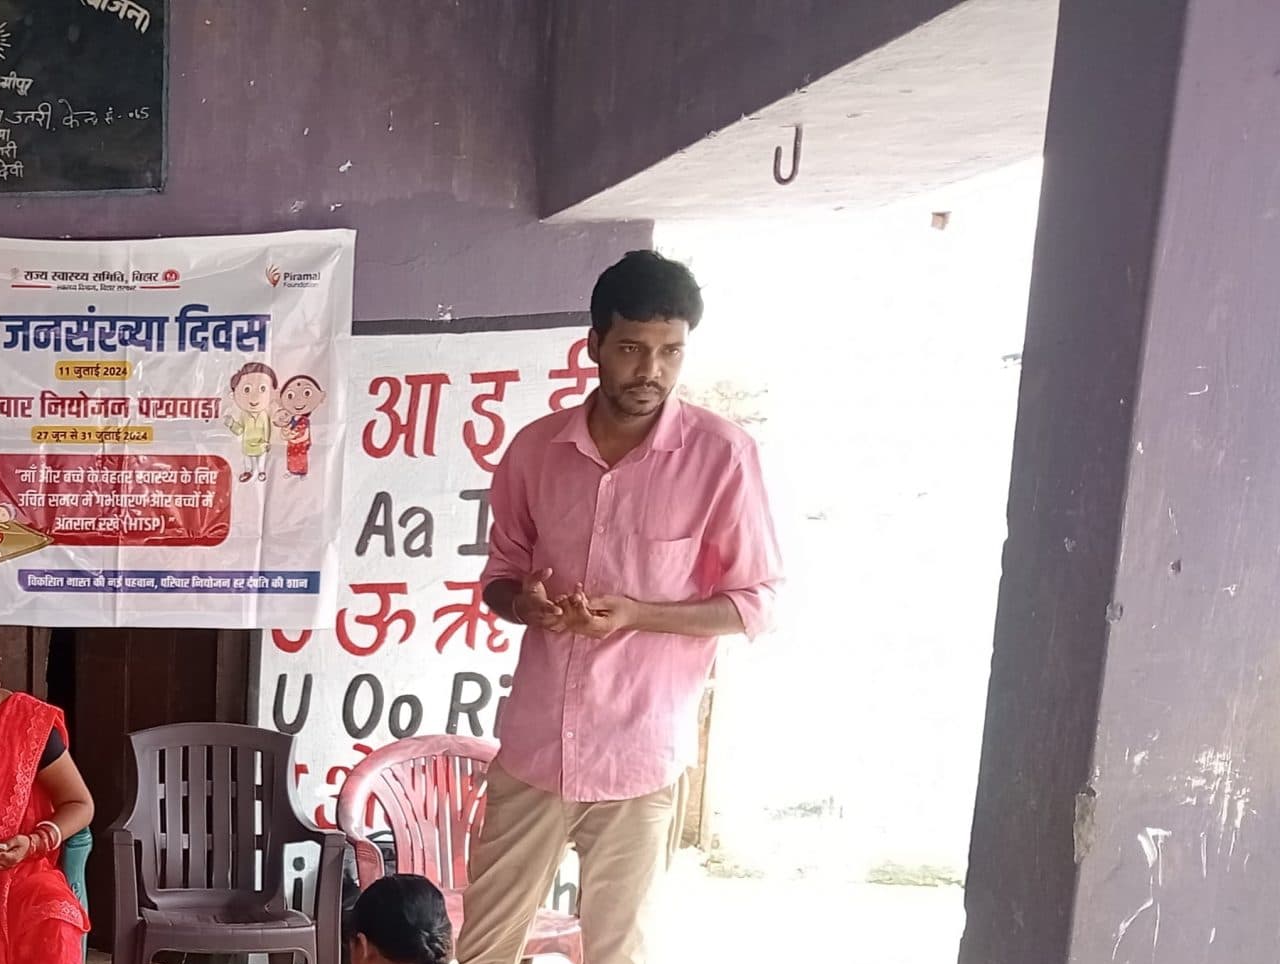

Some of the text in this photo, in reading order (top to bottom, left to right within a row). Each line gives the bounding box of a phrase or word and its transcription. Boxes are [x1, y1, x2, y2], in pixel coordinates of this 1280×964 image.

[24, 270, 48, 281] राज्य
[51, 270, 89, 282] स्वास्थ्य
[132, 270, 159, 282] बिहार
[284, 271, 320, 281] Piramal
[0, 305, 169, 352] जनसंख्या
[175, 304, 271, 352] दिवस
[58, 366, 128, 378] 11 जुलाई 2024
[40, 390, 130, 418] नियोजन
[138, 395, 222, 422] पखवाड़ा
[36, 427, 148, 443] 27 जून से 31 जुलाई 2024
[39, 464, 60, 484] और
[63, 467, 84, 484] बच्चे
[87, 466, 99, 484] के
[102, 466, 132, 484] बेहतर
[135, 469, 177, 484] स्वास्थ्य
[180, 467, 192, 484] के
[194, 467, 218, 484] लिए
[18, 491, 45, 508] उचित
[48, 493, 79, 508] समय
[95, 491, 146, 508] गर्भधारण
[149, 490, 171, 507] और
[174, 490, 200, 508] बच्चों
[201, 490, 215, 507] में
[55, 514, 95, 531] अंतराल
[355, 491, 434, 558] Aa
[160, 575, 189, 588] परिवार
[191, 575, 231, 588] नियोजन
[233, 578, 244, 588] हर
[271, 576, 283, 588] की
[286, 578, 308, 588] शान
